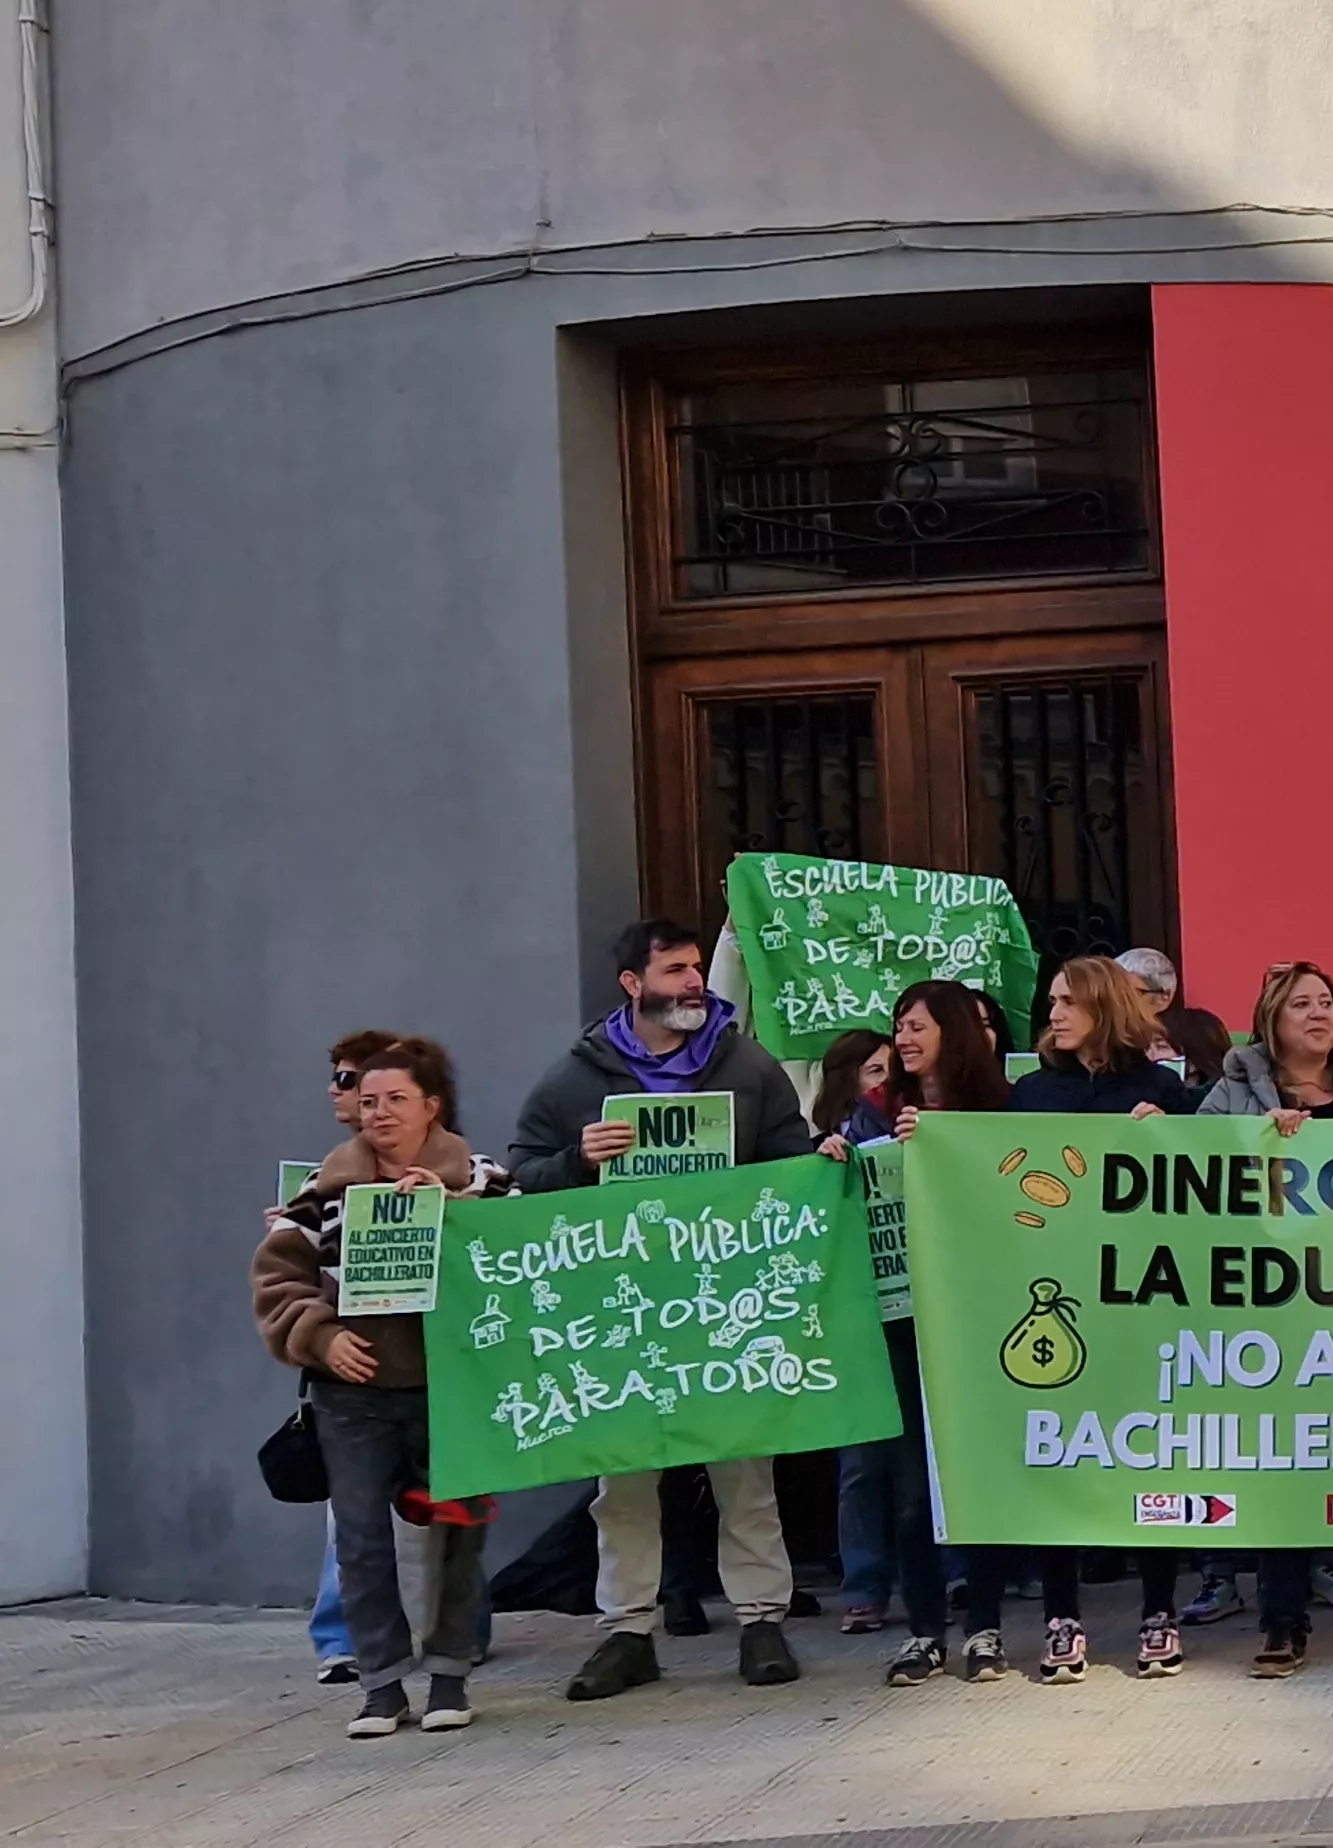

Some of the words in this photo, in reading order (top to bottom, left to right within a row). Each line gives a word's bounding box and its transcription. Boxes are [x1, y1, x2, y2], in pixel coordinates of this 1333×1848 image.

[768, 861, 898, 898] ESCUELA
[803, 937, 850, 964] DE
[869, 934, 992, 969] TOD@S
[785, 990, 891, 1026] PARA
[638, 1105, 696, 1148] NO!
[608, 1156, 629, 1176] AL
[632, 1152, 728, 1176] CONCIERTO
[371, 1193, 416, 1224] NO!
[349, 1229, 365, 1246] AL
[366, 1226, 436, 1245] CONCIERTO
[473, 1213, 650, 1286] ESCUELA
[664, 1205, 830, 1264] PÚBLICA:
[345, 1263, 434, 1283] BACHILLERATO
[348, 1246, 417, 1265] EDUCATIVO
[418, 1246, 435, 1261] EN
[1100, 1244, 1190, 1307] LA
[529, 1316, 598, 1357] DE
[621, 1286, 801, 1337] TOD@S
[1157, 1329, 1281, 1402] ¡NO
[507, 1370, 655, 1438] PARA
[666, 1353, 838, 1395] TOD@S
[1141, 1494, 1177, 1508] CGT
